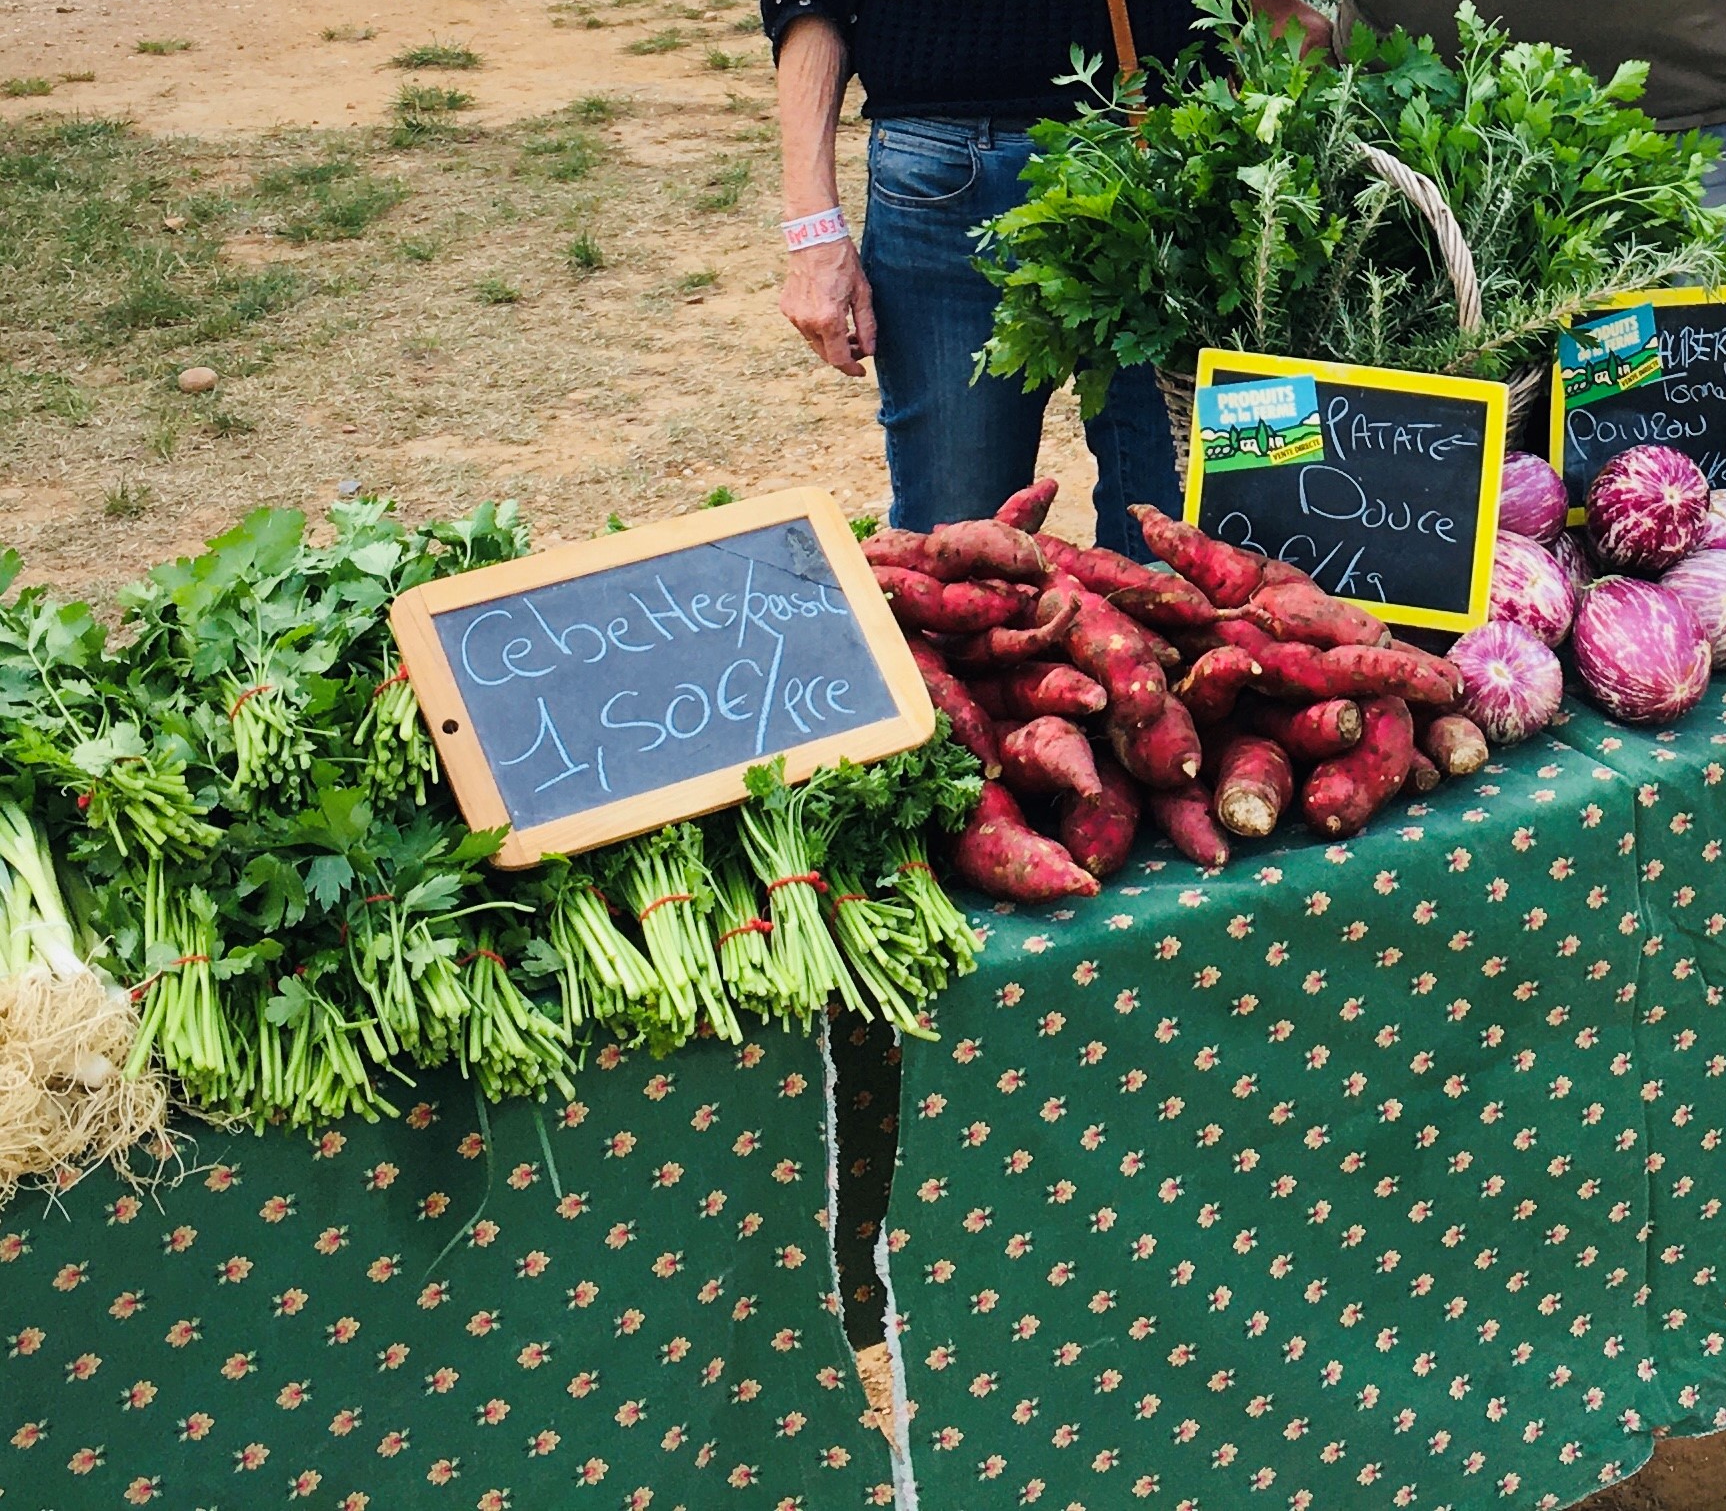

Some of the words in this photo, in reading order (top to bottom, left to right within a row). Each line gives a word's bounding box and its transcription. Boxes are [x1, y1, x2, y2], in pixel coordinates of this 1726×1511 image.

[1583, 315, 1640, 344] ODUITS
[1218, 386, 1295, 409] PRODUITS
[1220, 409, 1238, 424] de
[1238, 407, 1252, 422] la
[1252, 403, 1298, 420] FERME
[1326, 396, 1478, 462] PATATE
[1272, 448, 1294, 461] VENTE
[1294, 438, 1321, 455] DIRECTE
[1299, 464, 1457, 544] Douce
